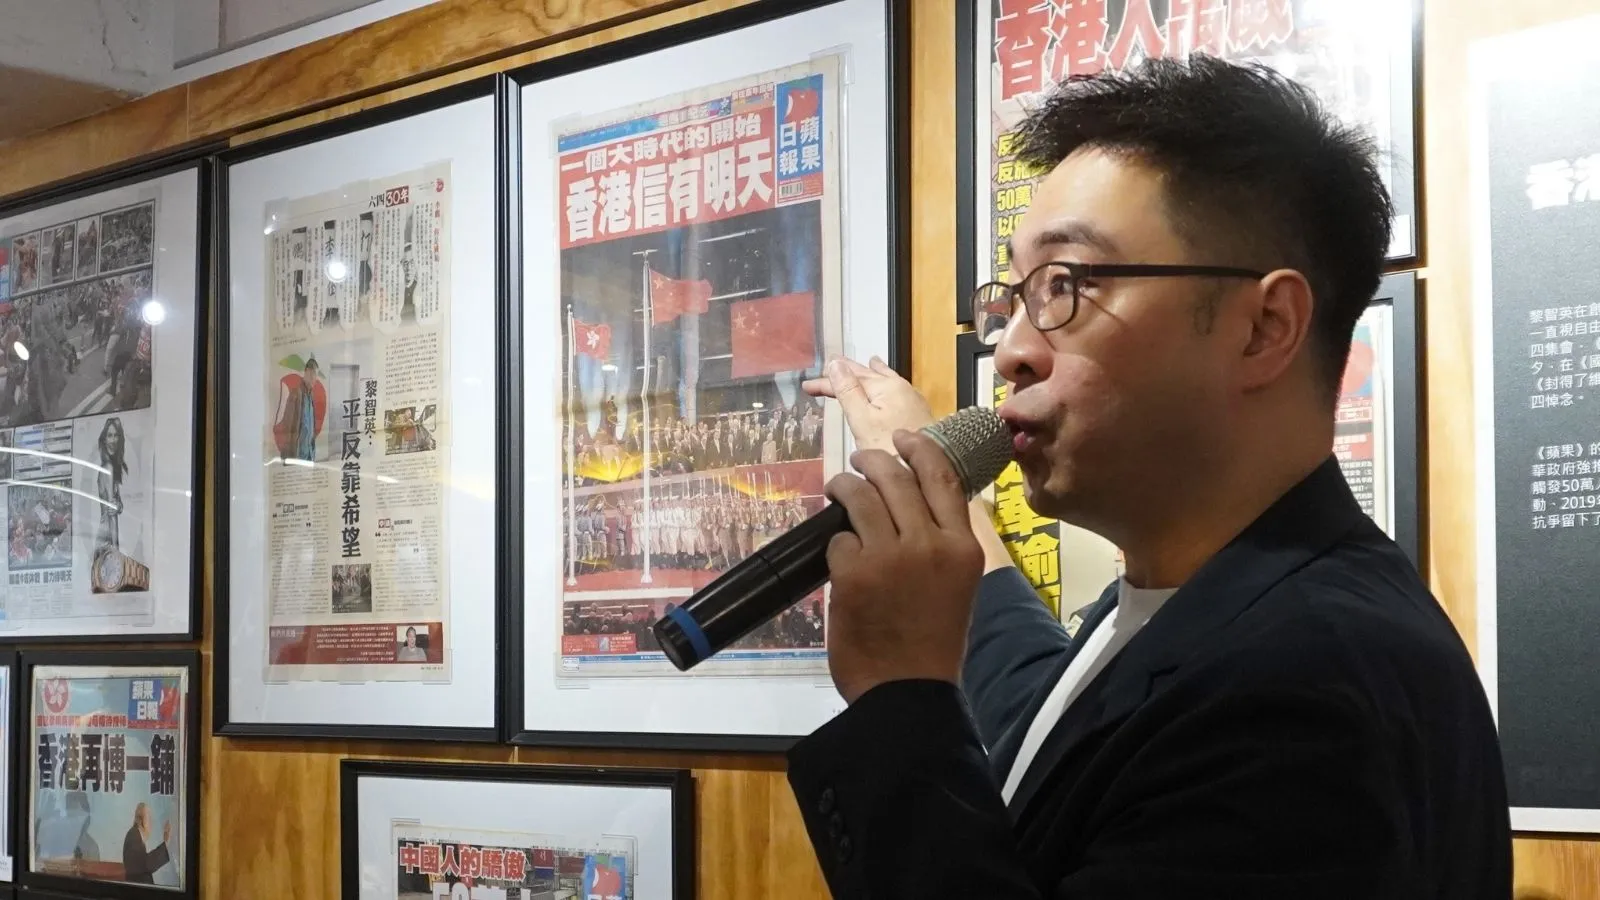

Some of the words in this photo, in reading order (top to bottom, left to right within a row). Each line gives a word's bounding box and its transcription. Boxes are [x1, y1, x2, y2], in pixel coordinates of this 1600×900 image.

[561, 113, 761, 174] 一個大時代的開始
[779, 120, 798, 176] 日報
[800, 115, 820, 170] 蘋果
[565, 139, 773, 243] 香港信有明天
[341, 398, 361, 558] 平反靠希望
[399, 842, 527, 881] 中國人的驕傲
